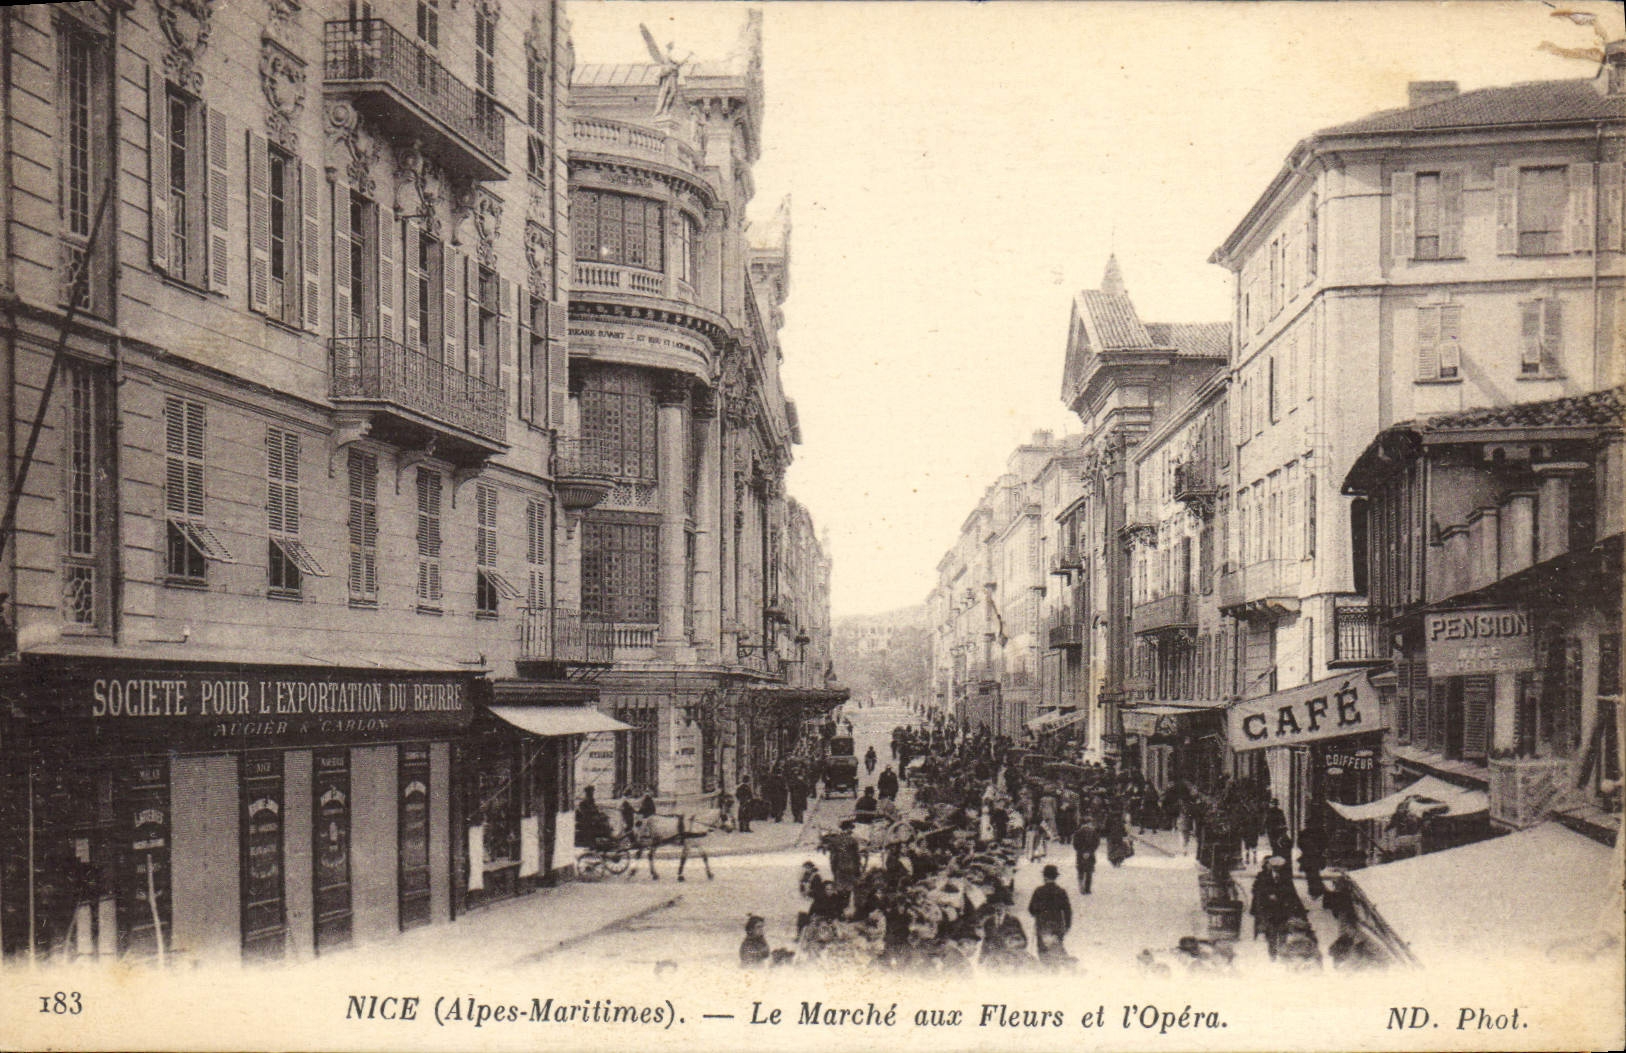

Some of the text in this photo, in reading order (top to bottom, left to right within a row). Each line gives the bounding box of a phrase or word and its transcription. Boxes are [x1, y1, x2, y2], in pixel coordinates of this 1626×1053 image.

[1430, 613, 1529, 641] PENSION
[92, 679, 462, 716] SOCIETE POUR L'EXPORTATION DU BEURRE
[1242, 681, 1362, 742] CAFÉ
[1325, 754, 1374, 770] COIFFEUR
